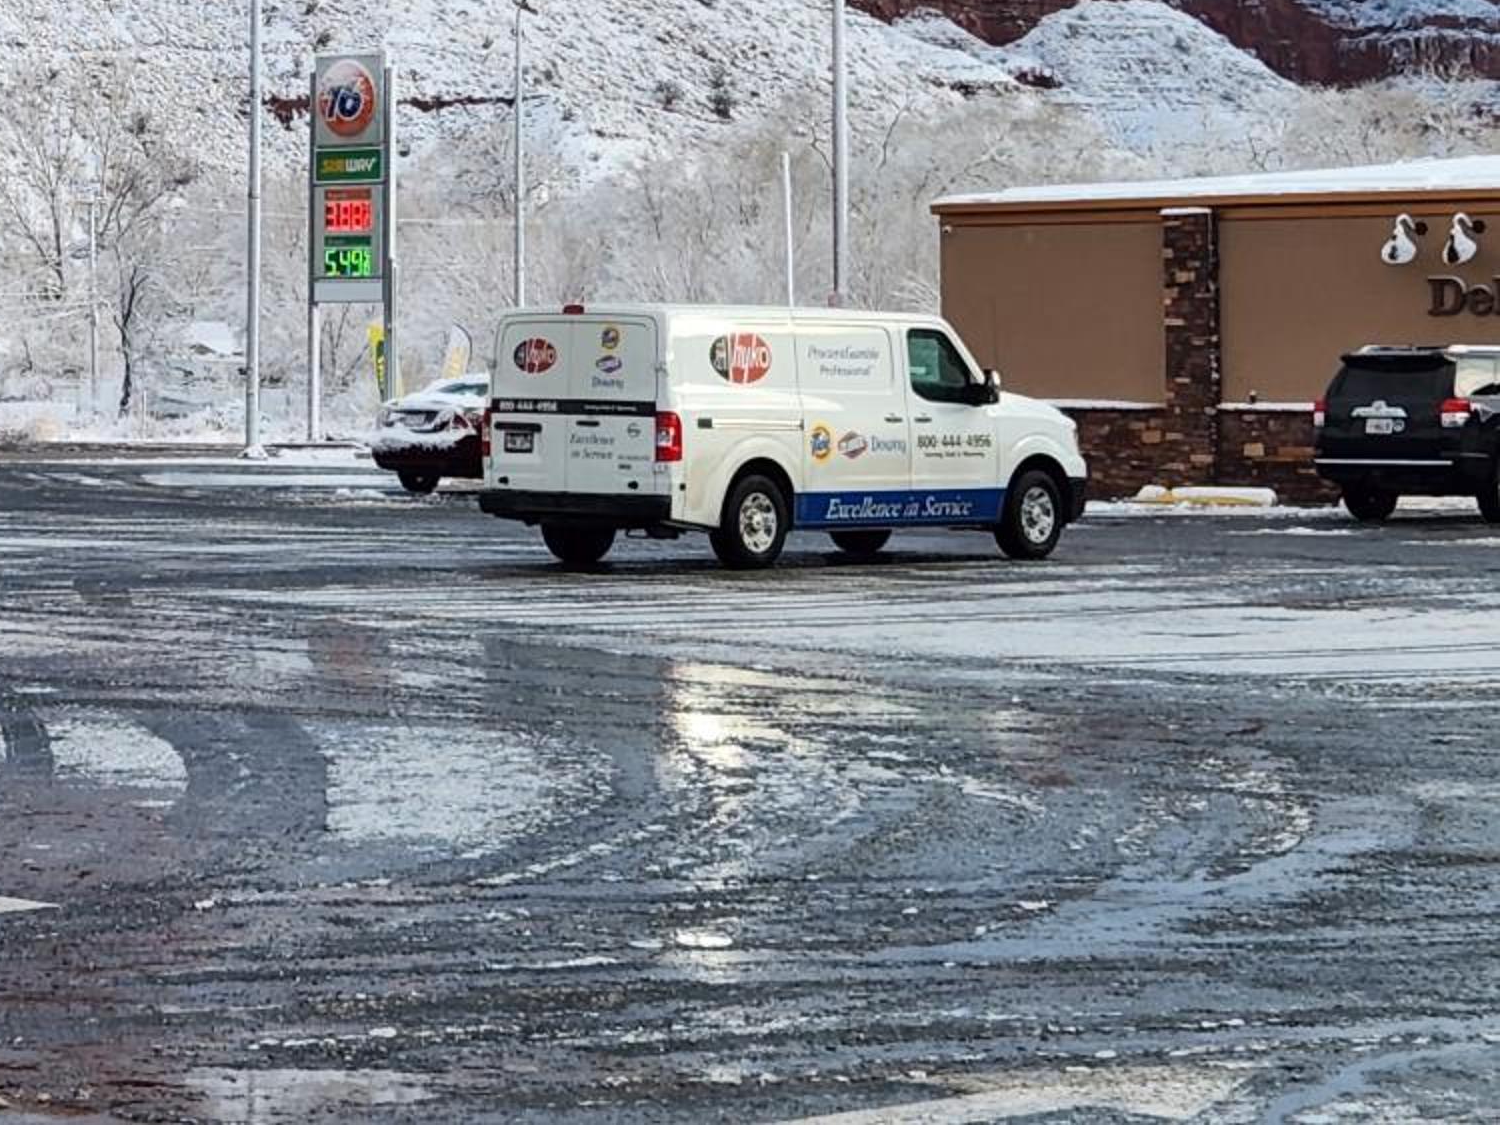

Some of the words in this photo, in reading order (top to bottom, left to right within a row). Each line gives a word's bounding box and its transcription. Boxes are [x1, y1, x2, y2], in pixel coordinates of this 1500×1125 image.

[323, 157, 377, 173] SUBWAY
[871, 436, 907, 453] Downy
[826, 496, 901, 520] Excellence
[903, 496, 919, 517] in
[921, 494, 973, 517] Service
